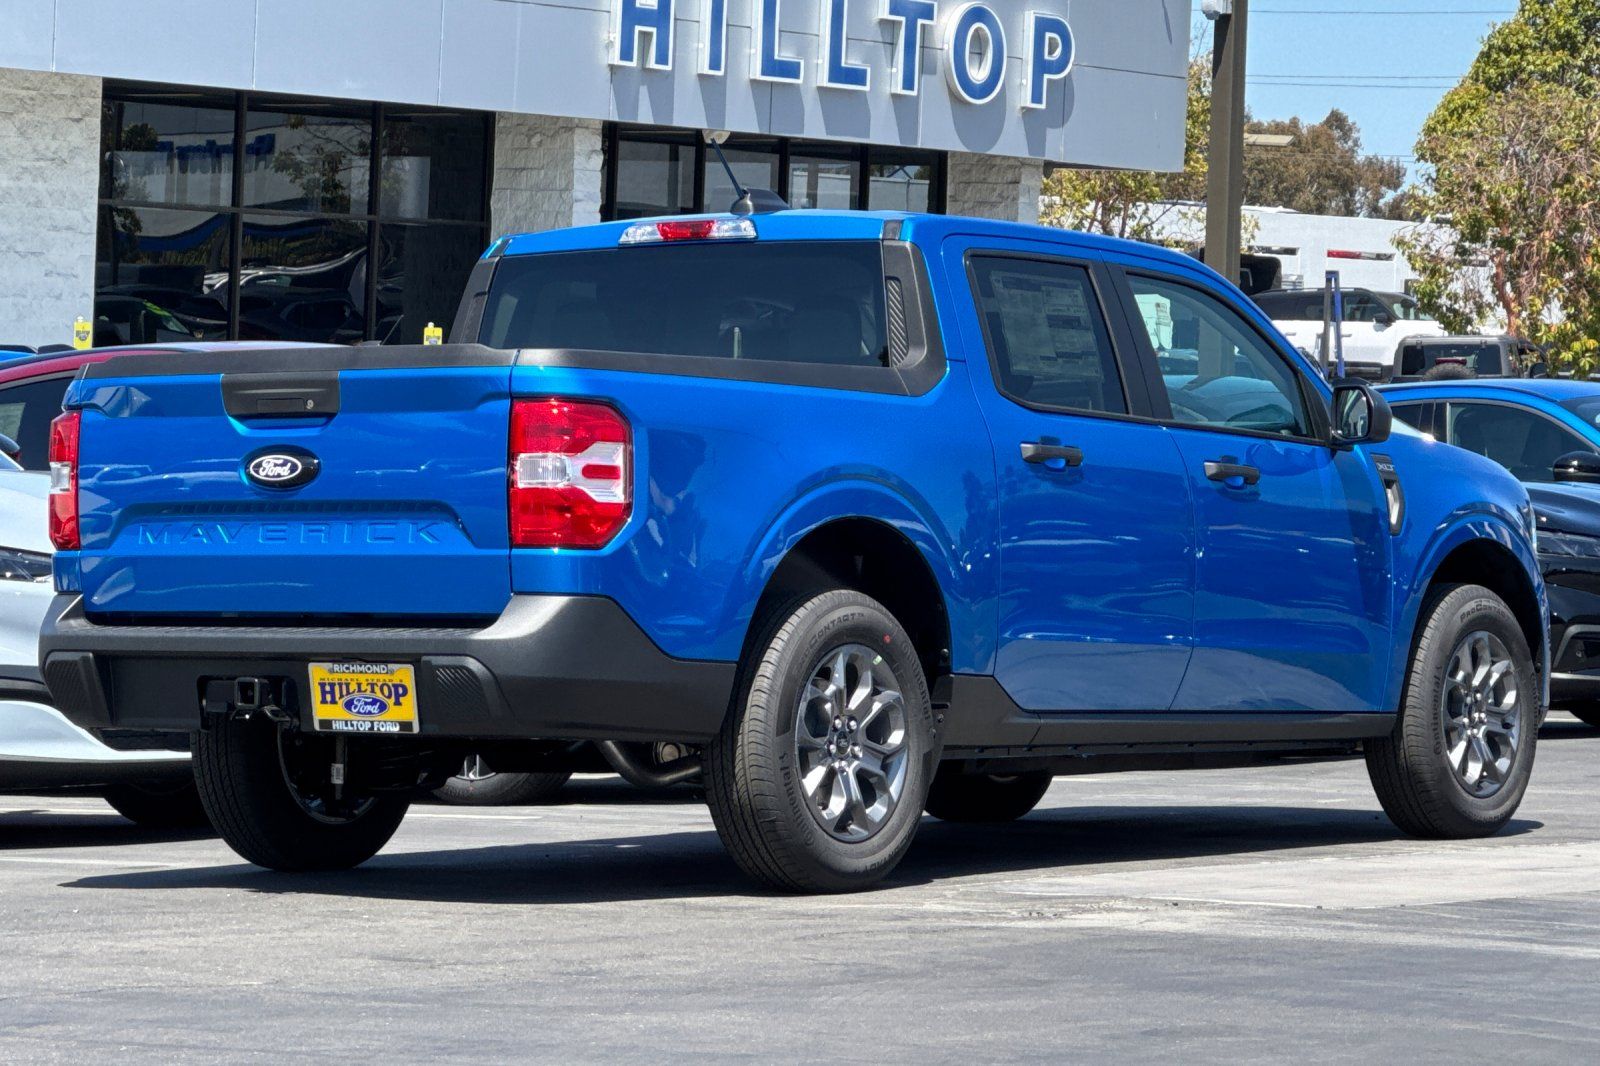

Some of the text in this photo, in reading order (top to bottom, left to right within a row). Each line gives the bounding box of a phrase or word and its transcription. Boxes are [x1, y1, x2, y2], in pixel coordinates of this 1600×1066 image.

[608, 0, 1075, 108] HILLTOP
[259, 458, 291, 477] Ford
[137, 522, 441, 544] MAVERICK
[333, 664, 388, 674] RICHMOND
[318, 682, 408, 706] HILLTOP
[351, 697, 380, 714] Ford
[332, 720, 400, 732] HILLTOP FORD
